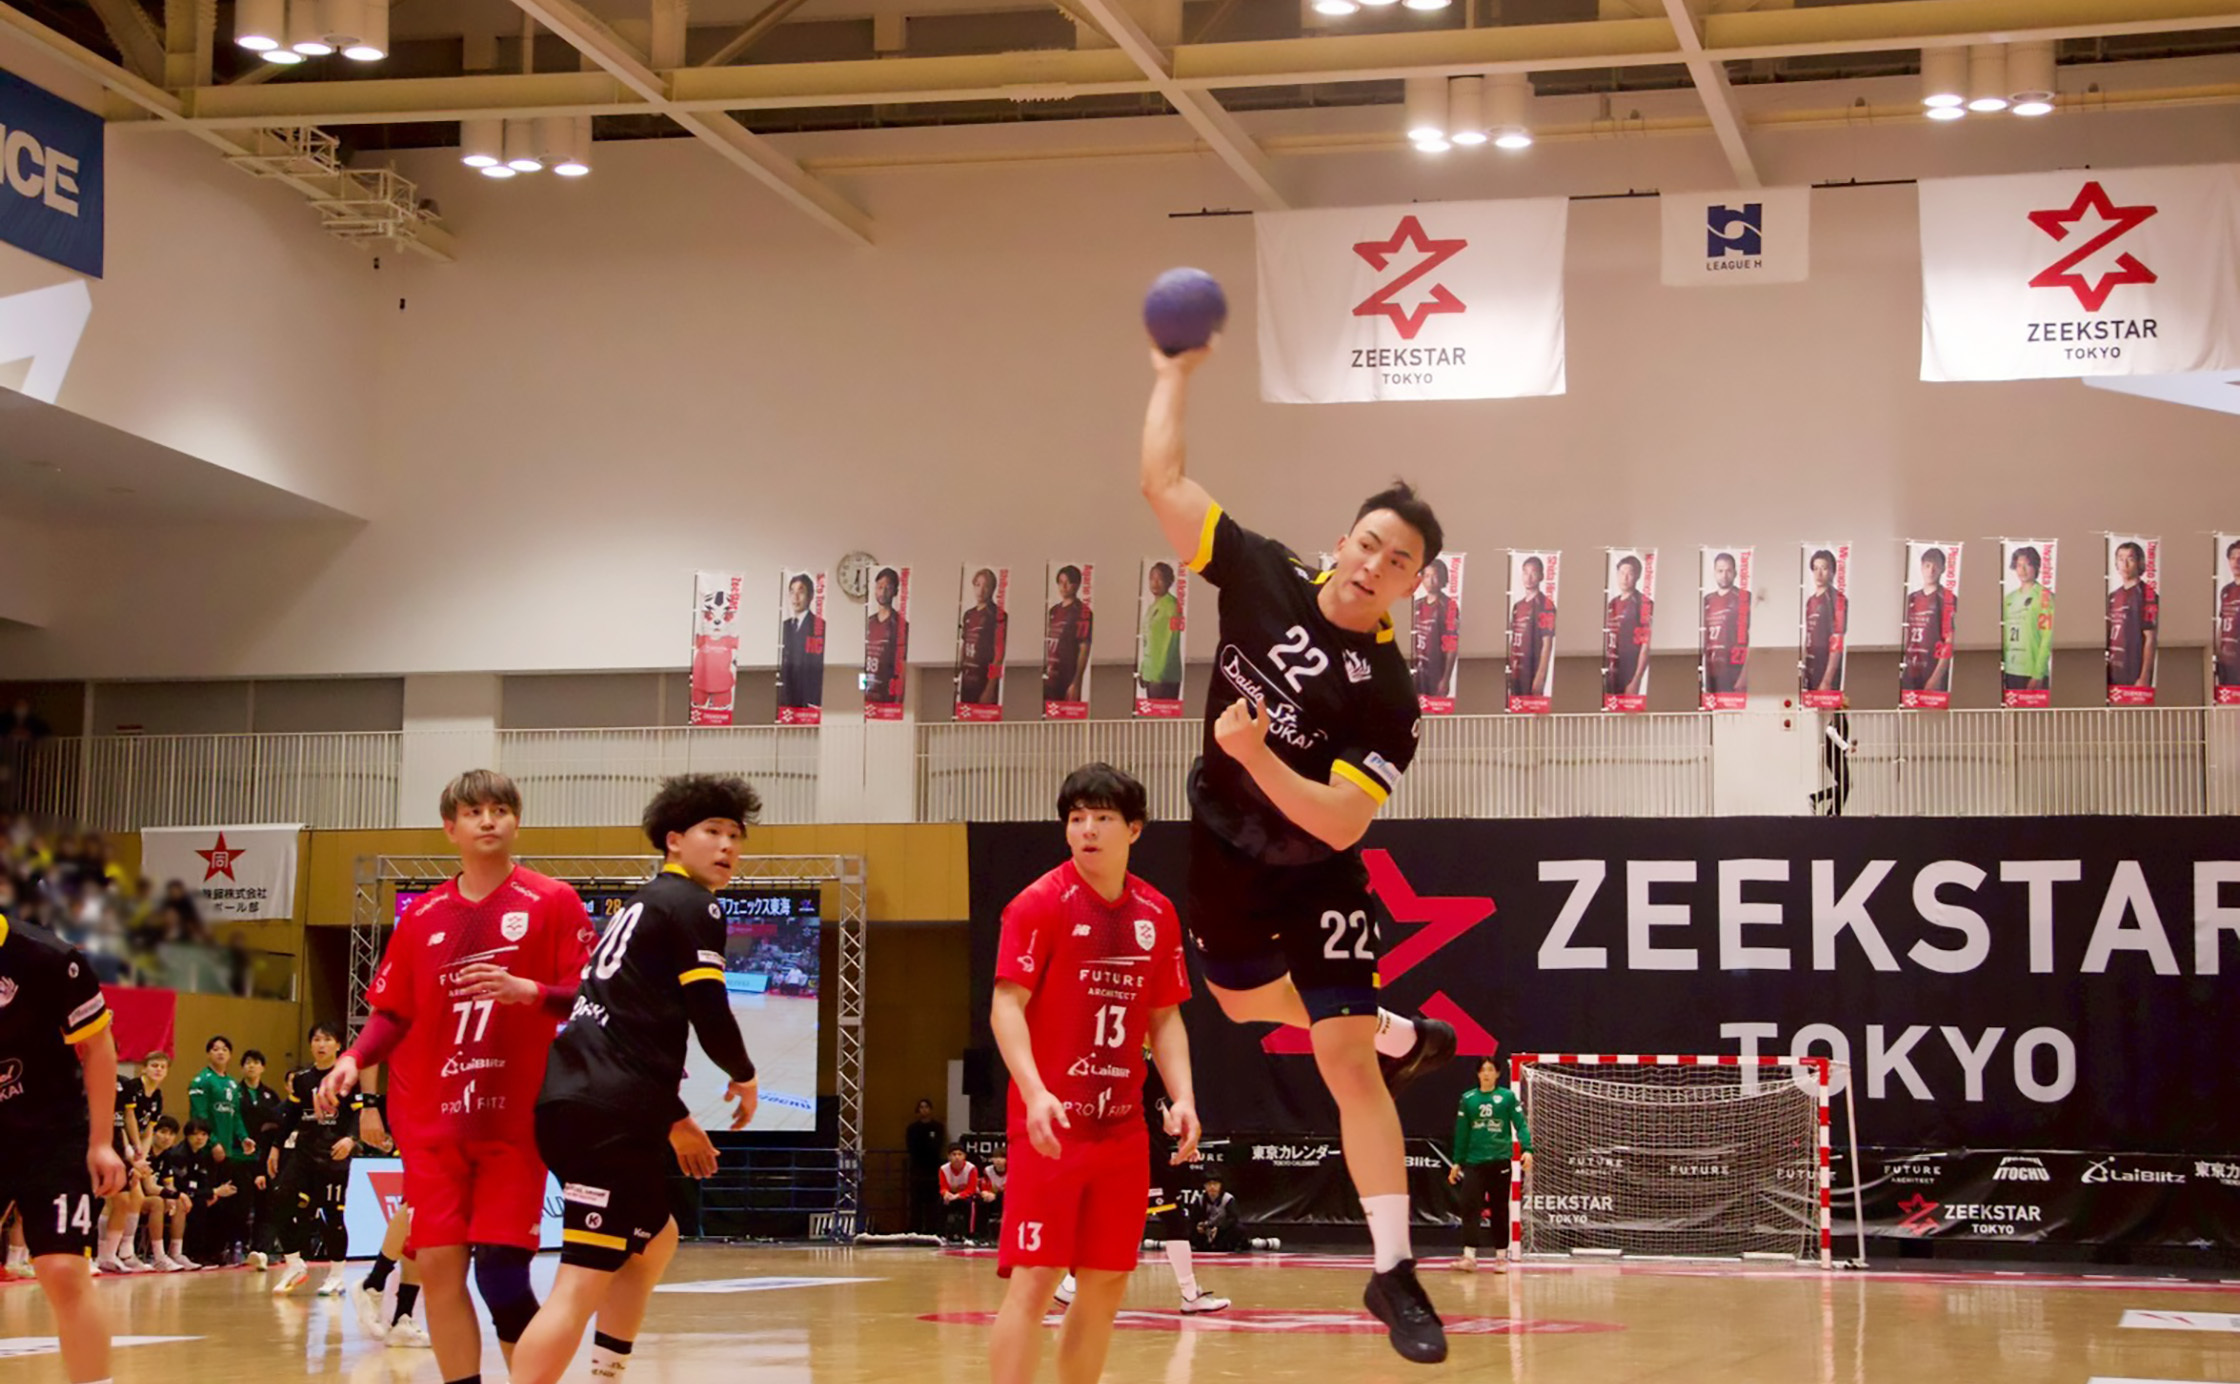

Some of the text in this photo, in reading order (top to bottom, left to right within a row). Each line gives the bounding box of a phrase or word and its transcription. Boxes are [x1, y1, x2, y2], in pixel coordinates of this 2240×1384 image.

[1706, 259, 1763, 271] LEAGUE H
[2027, 319, 2158, 342] ZEEKSTAR
[1351, 347, 1466, 368] ZEEKSTAR
[2065, 347, 2121, 360] TOKYO
[1382, 372, 1433, 385] TOKYO
[1267, 625, 1329, 693] 22
[1320, 910, 1374, 959] 22
[1079, 969, 1145, 989] FUTURE
[453, 1001, 494, 1045] 77
[1094, 1004, 1127, 1049] 13
[1718, 1022, 2077, 1103] TOKYO
[1251, 1144, 1341, 1160] 東京カレンダー
[1670, 1165, 1730, 1176] FUTURE
[1884, 1165, 1942, 1176] FUTURE
[2110, 1168, 2186, 1184] LaiBlitz
[326, 1184, 342, 1202] 11
[1523, 1195, 1613, 1211] ZEEKSTAR
[53, 1193, 92, 1236] 14
[1548, 1214, 1589, 1224] TOKYO
[1944, 1204, 2042, 1222] ZEEKSTAR
[1017, 1221, 1043, 1251] 13
[1972, 1223, 2015, 1235] TOKYO
